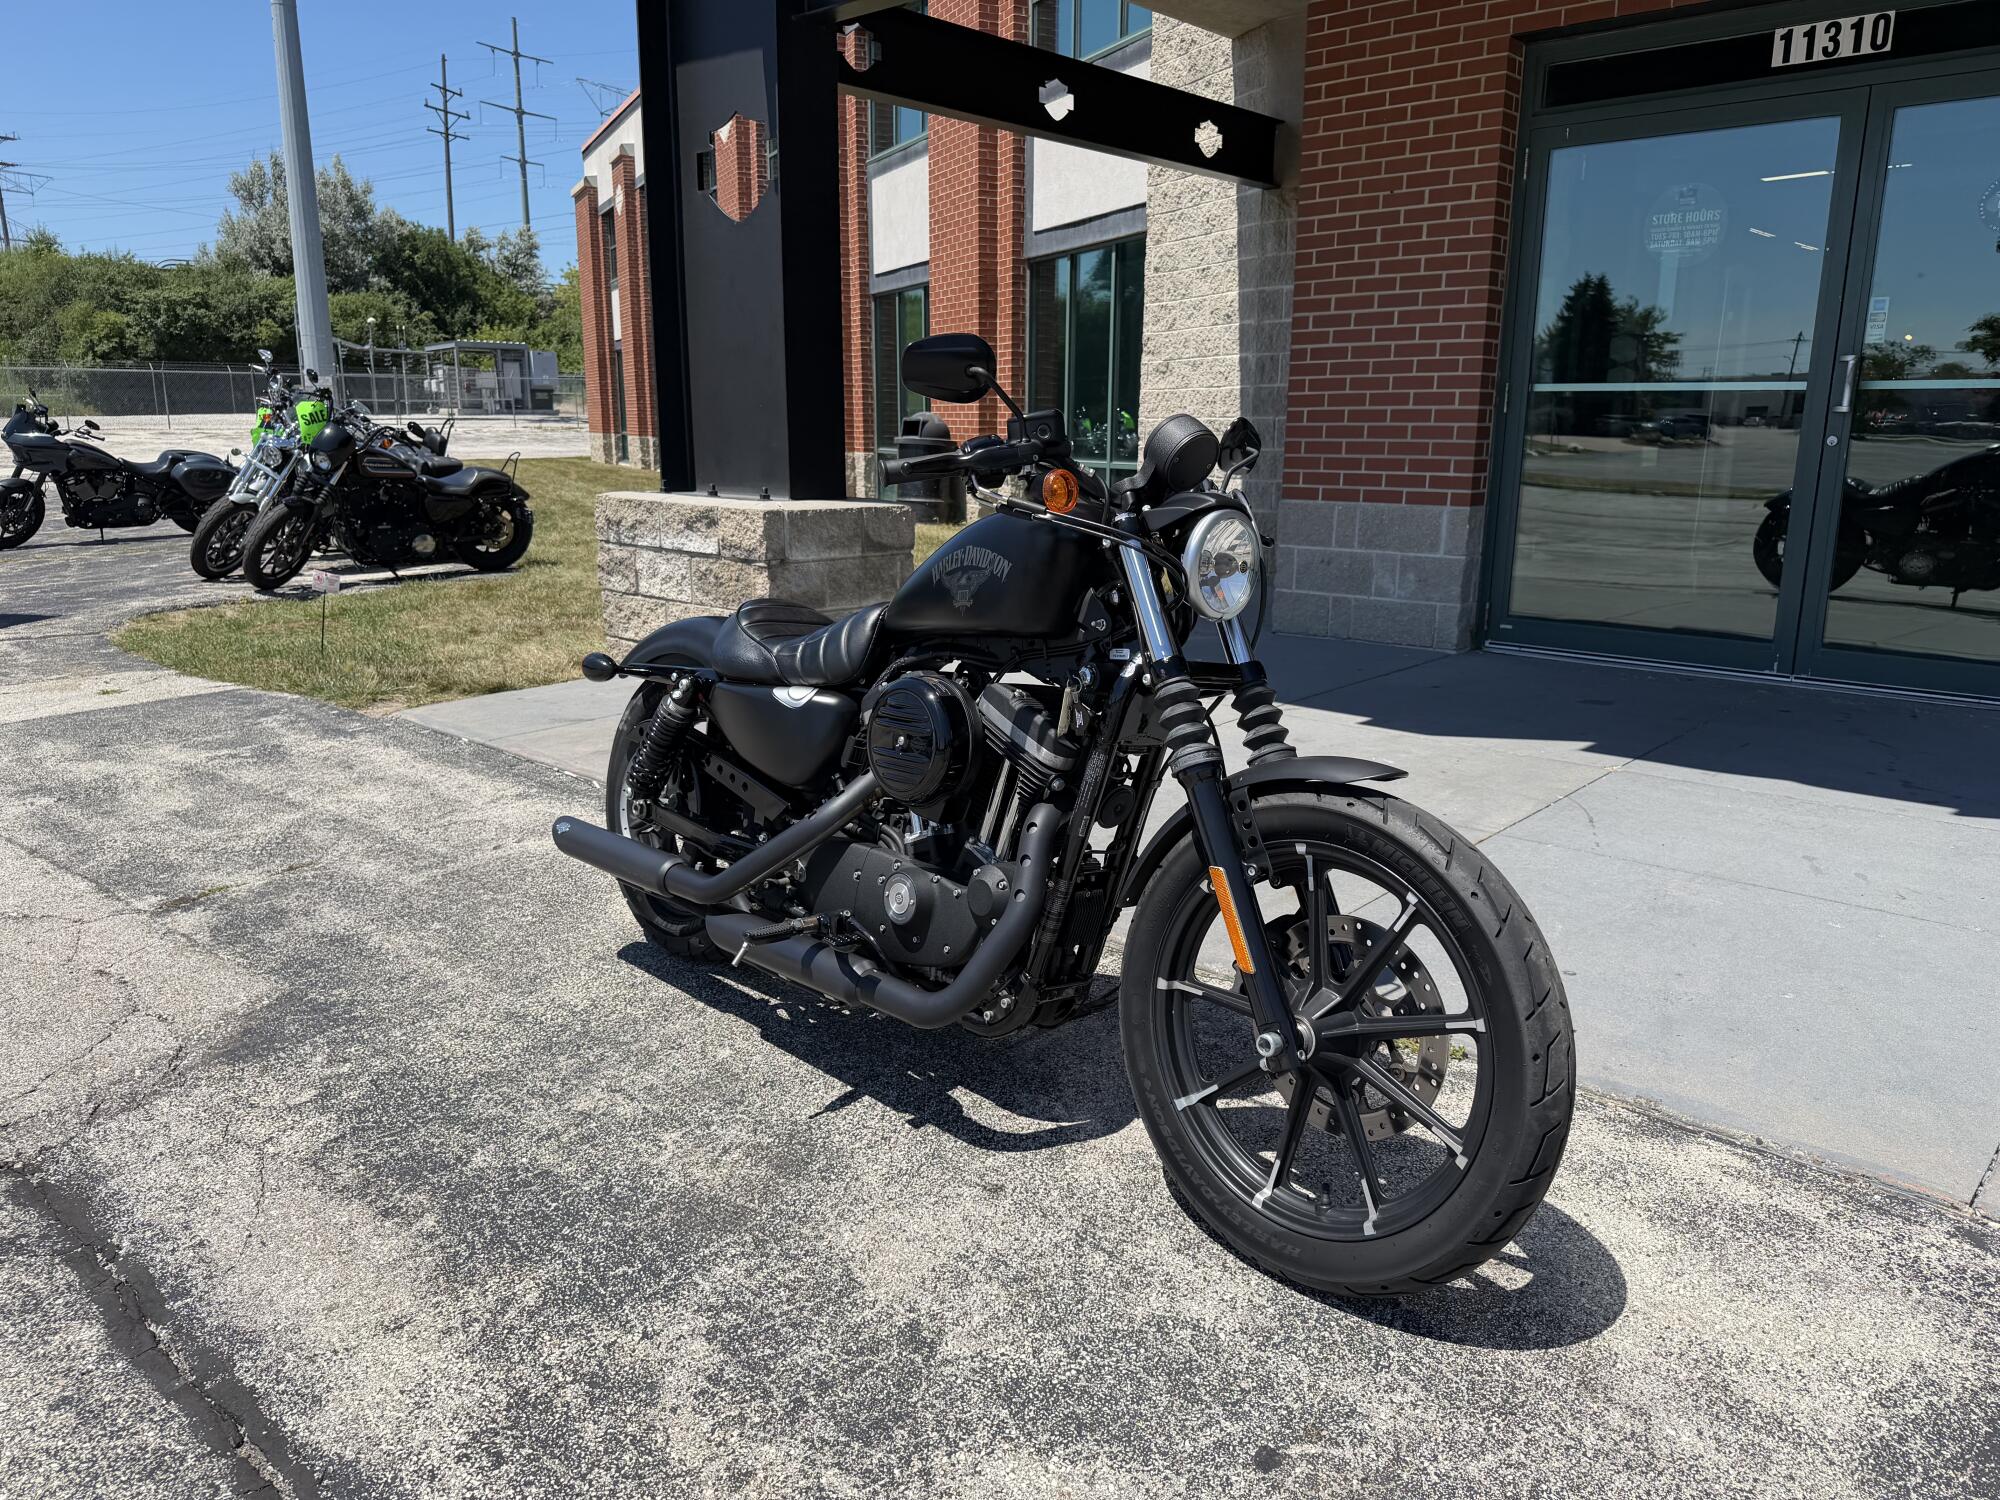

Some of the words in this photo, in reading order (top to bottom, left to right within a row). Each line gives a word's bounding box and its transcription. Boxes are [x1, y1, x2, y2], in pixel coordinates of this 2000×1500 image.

[1779, 13, 1892, 64] 11310
[1652, 212, 1683, 225] STORE
[1686, 208, 1721, 222] HOURS
[301, 410, 327, 426] SALE
[931, 545, 1013, 585] HARLEY-DAVIDSON
[1371, 839, 1469, 928] MICHELIN
